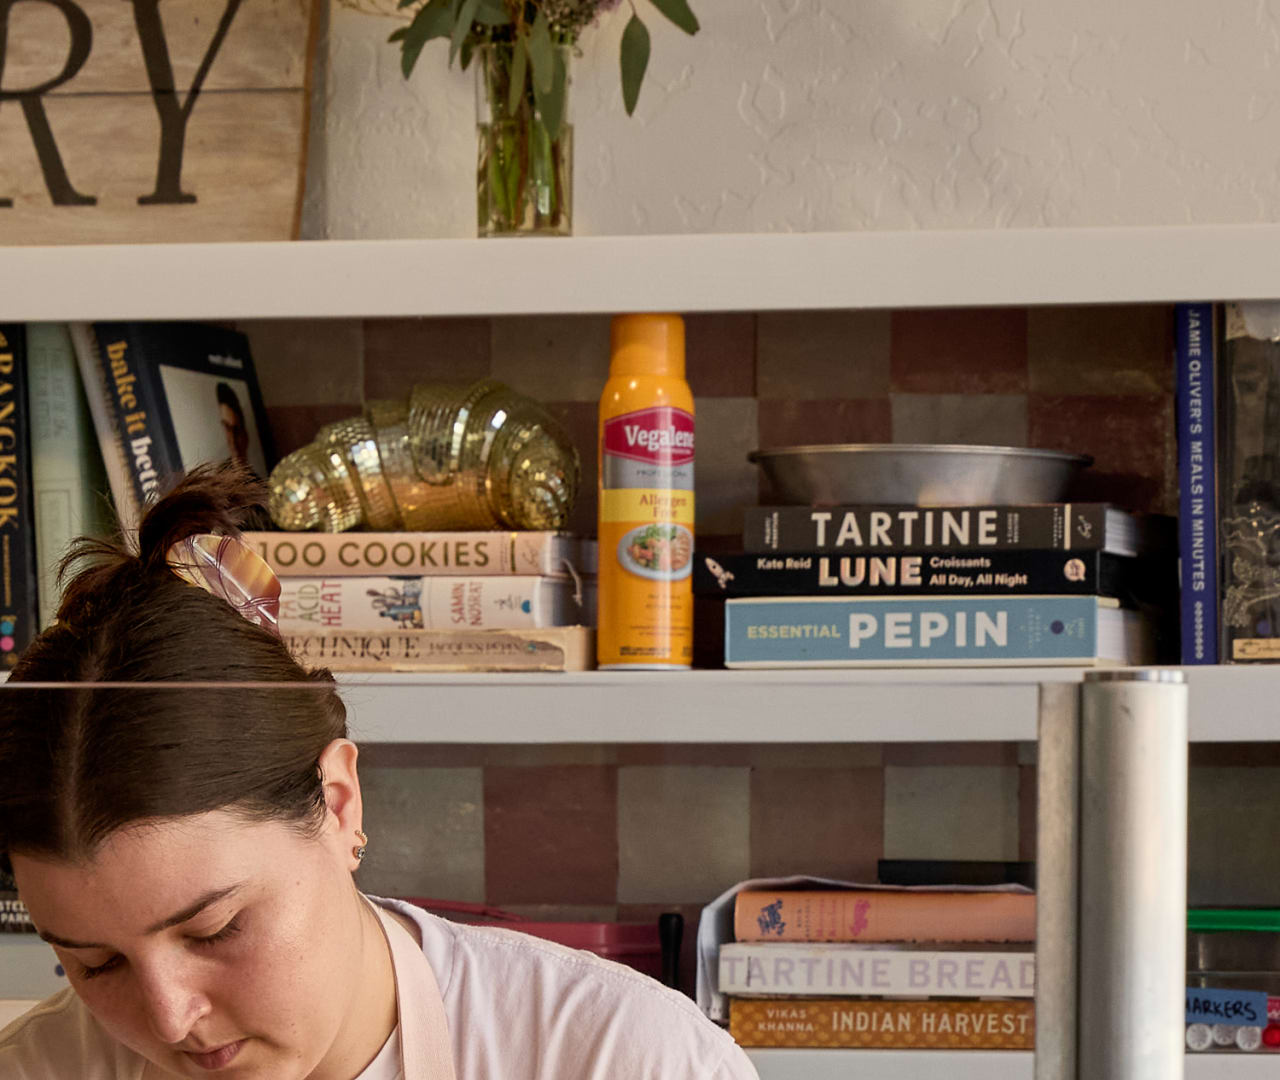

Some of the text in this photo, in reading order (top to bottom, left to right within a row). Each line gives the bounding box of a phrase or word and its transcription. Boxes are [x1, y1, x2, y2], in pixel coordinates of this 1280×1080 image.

[107, 340, 161, 505] bake it bette
[1187, 309, 1205, 593] JAMIE OLIVER'S MEALS IN MINUTES
[811, 510, 998, 547] TARTINE
[338, 542, 490, 567] COOKIES
[929, 556, 992, 570] Croissants
[757, 556, 923, 588] Kate Reid LUNE
[929, 573, 1029, 588] All Day, All Night
[298, 584, 319, 623] ACID
[321, 580, 343, 627] HEAT
[451, 583, 466, 624] SAMIN
[746, 623, 842, 640] ESSENTIAL
[849, 611, 1009, 649] PEPIN
[286, 635, 421, 661] ECHNIQUE
[720, 956, 891, 988] TARTINE
[757, 1021, 814, 1033] KHANNA
[767, 1009, 807, 1020] VIKAS
[831, 1011, 1030, 1036] INDIAN HARVEST
